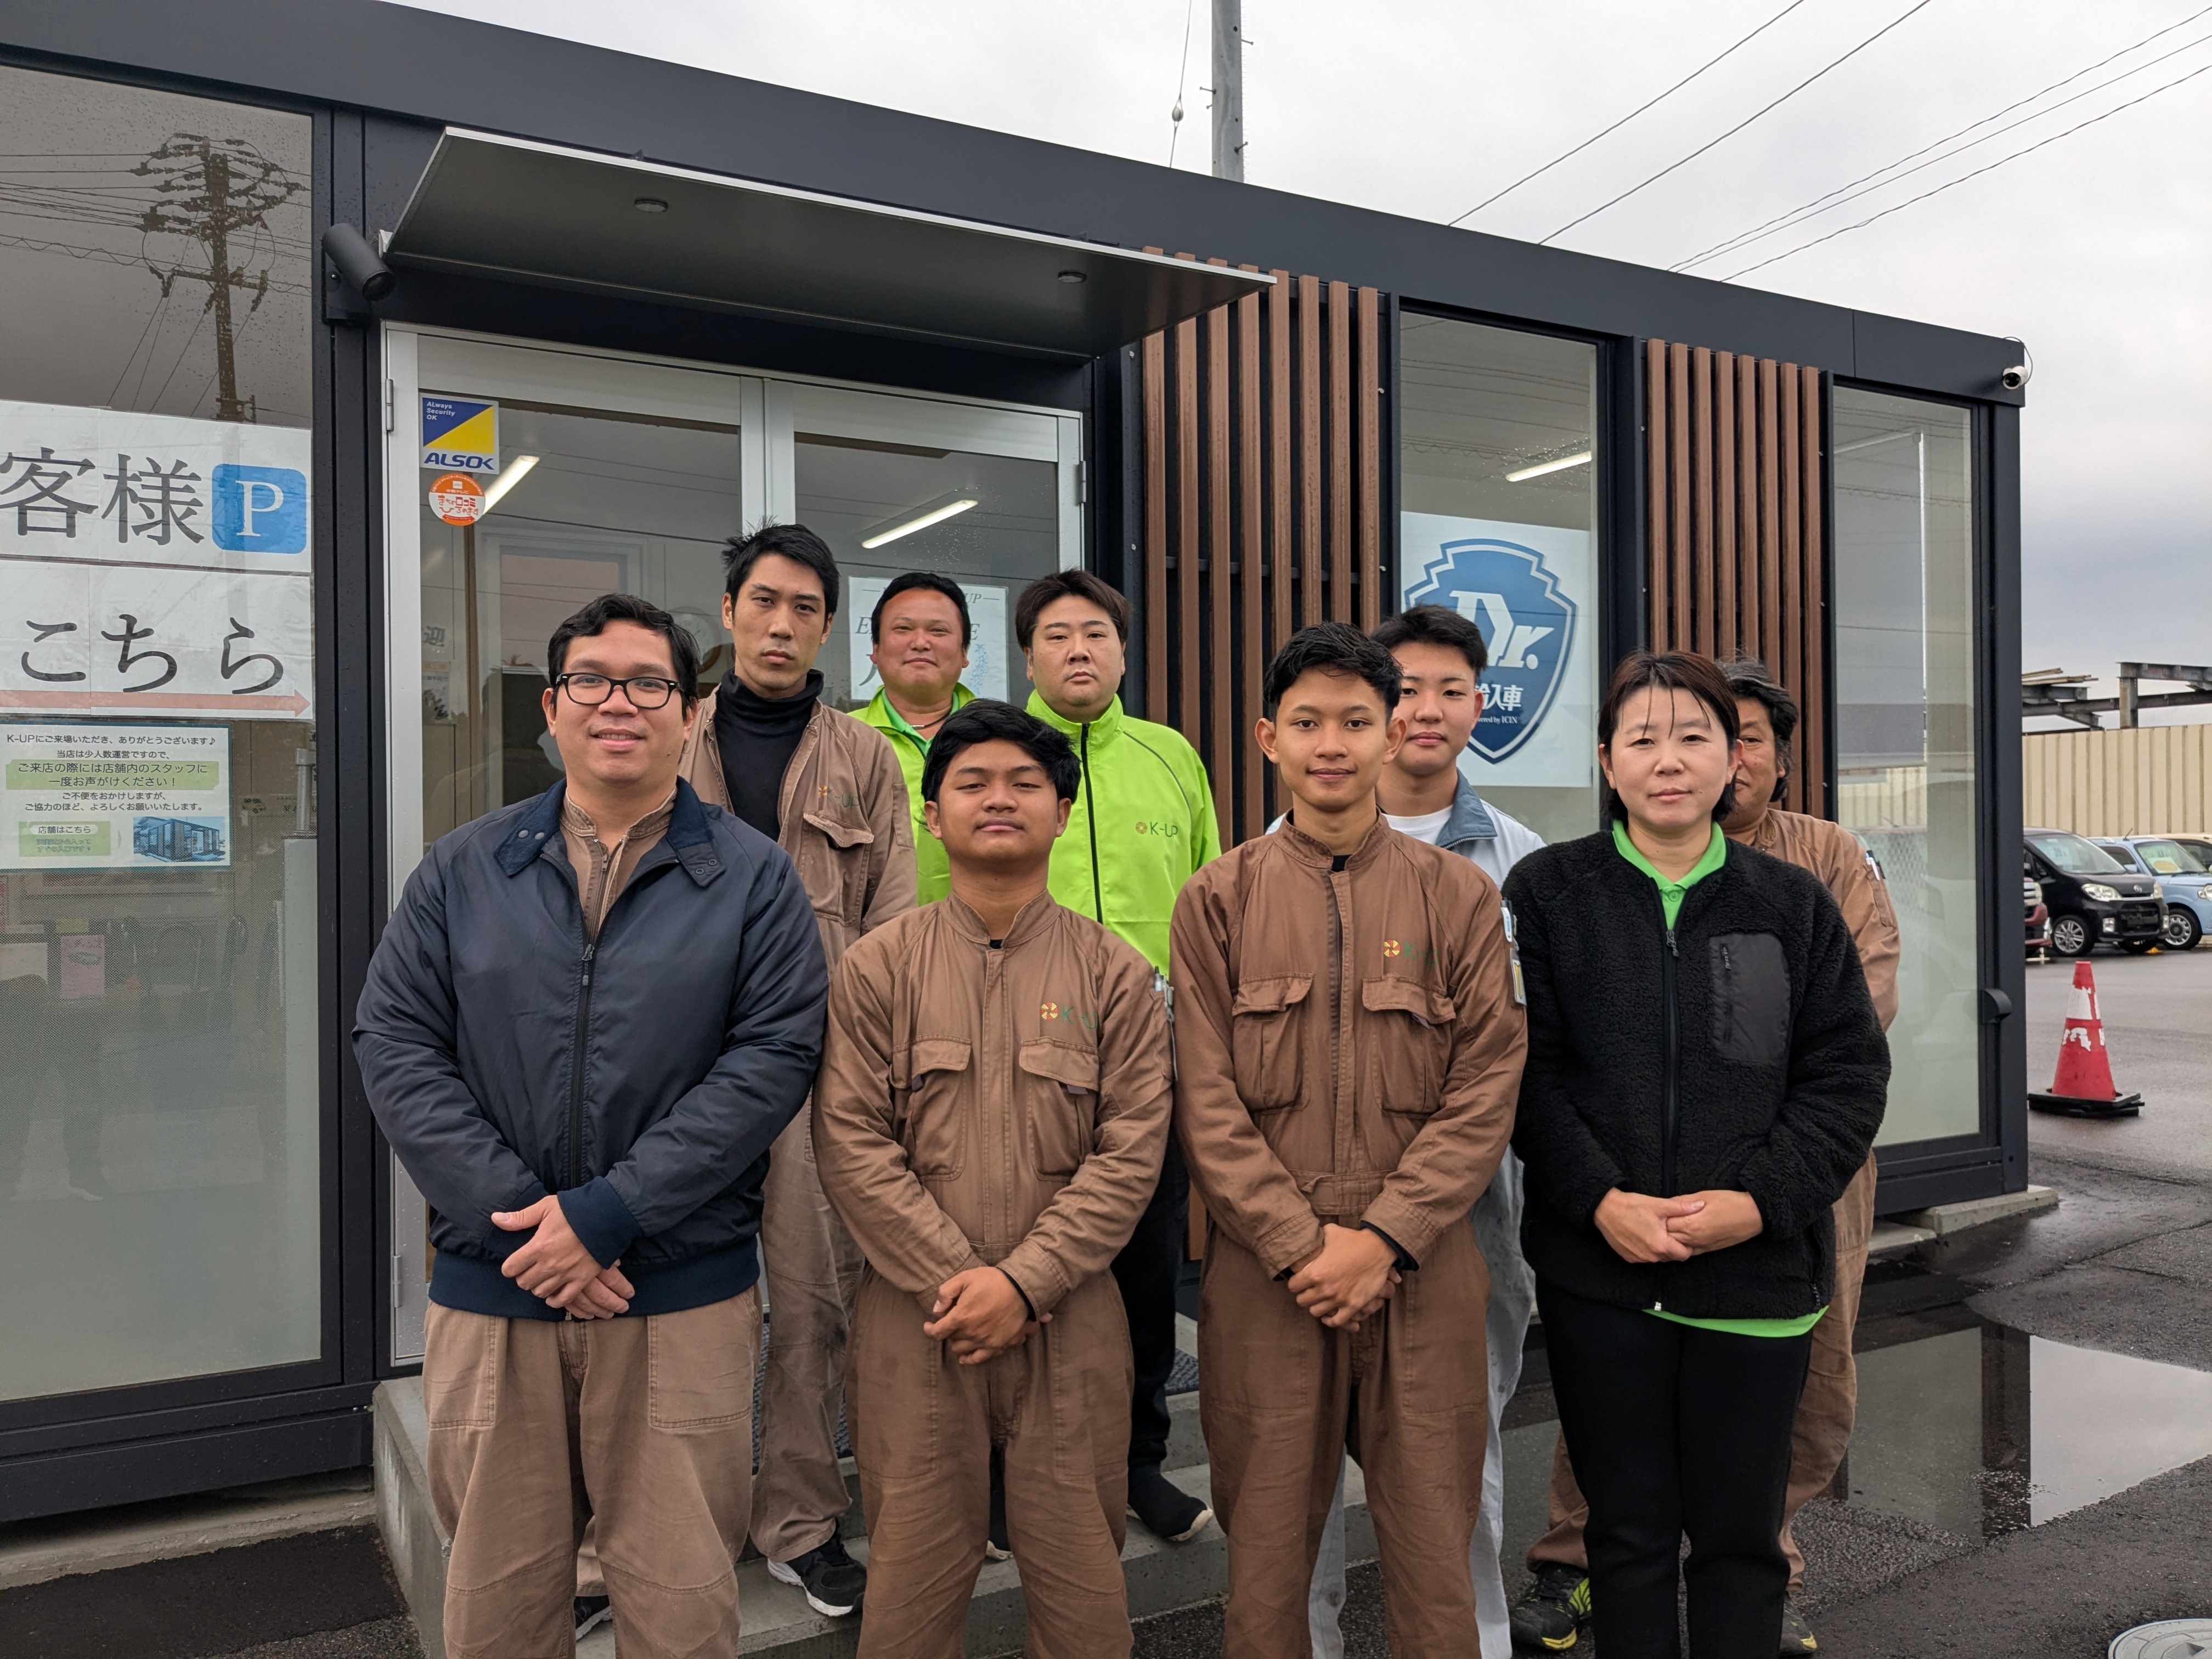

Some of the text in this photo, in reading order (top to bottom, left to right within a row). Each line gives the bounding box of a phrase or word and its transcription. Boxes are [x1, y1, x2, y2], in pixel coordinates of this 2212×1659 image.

[426, 408, 455, 417] Security
[427, 401, 452, 410] ALways
[424, 452, 495, 471] ALSOK
[0, 447, 284, 546] 客様 P
[21, 614, 284, 694] こちら
[18, 763, 208, 774] ご来店の際には店舗内のスタッフに
[1150, 822, 1178, 837] K-UP
[1062, 1005, 1097, 1030] K-U
